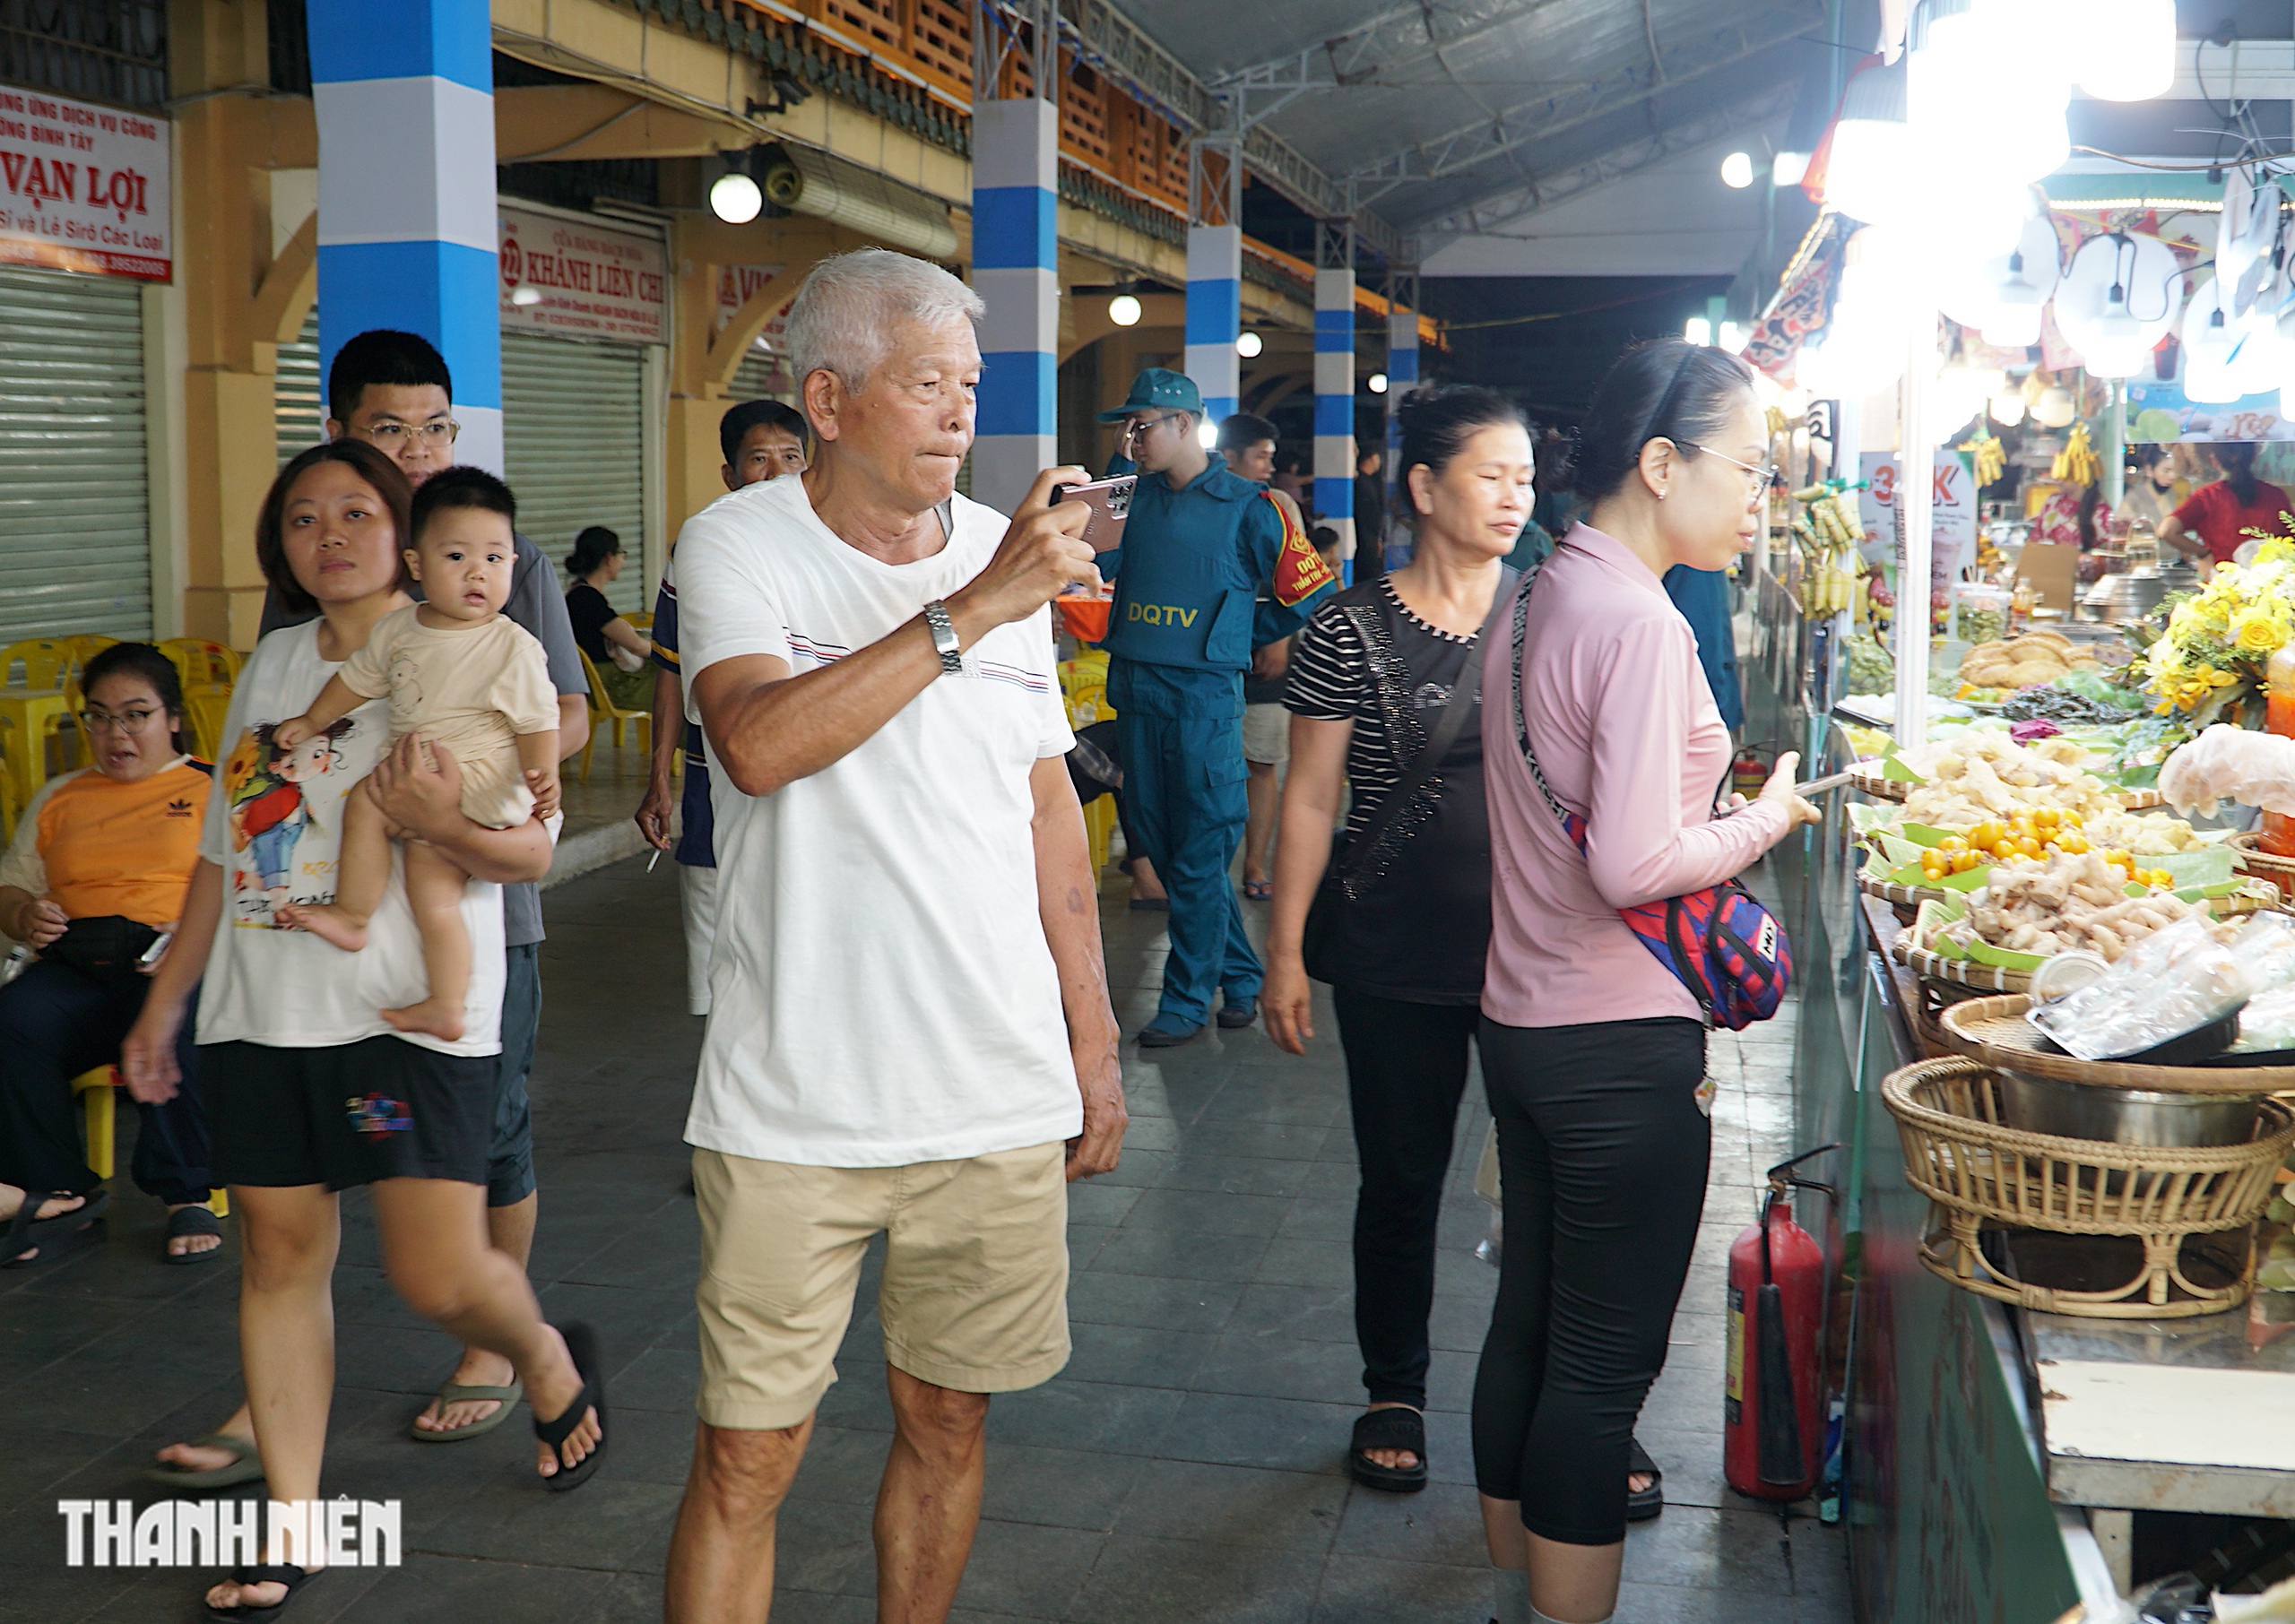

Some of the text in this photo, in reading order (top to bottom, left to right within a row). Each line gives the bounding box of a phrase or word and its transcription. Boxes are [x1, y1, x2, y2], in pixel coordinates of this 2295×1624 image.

[0, 151, 148, 223] VẠN LỢI
[526, 247, 593, 293] KHÁNH
[1127, 602, 1199, 628] DQTV
